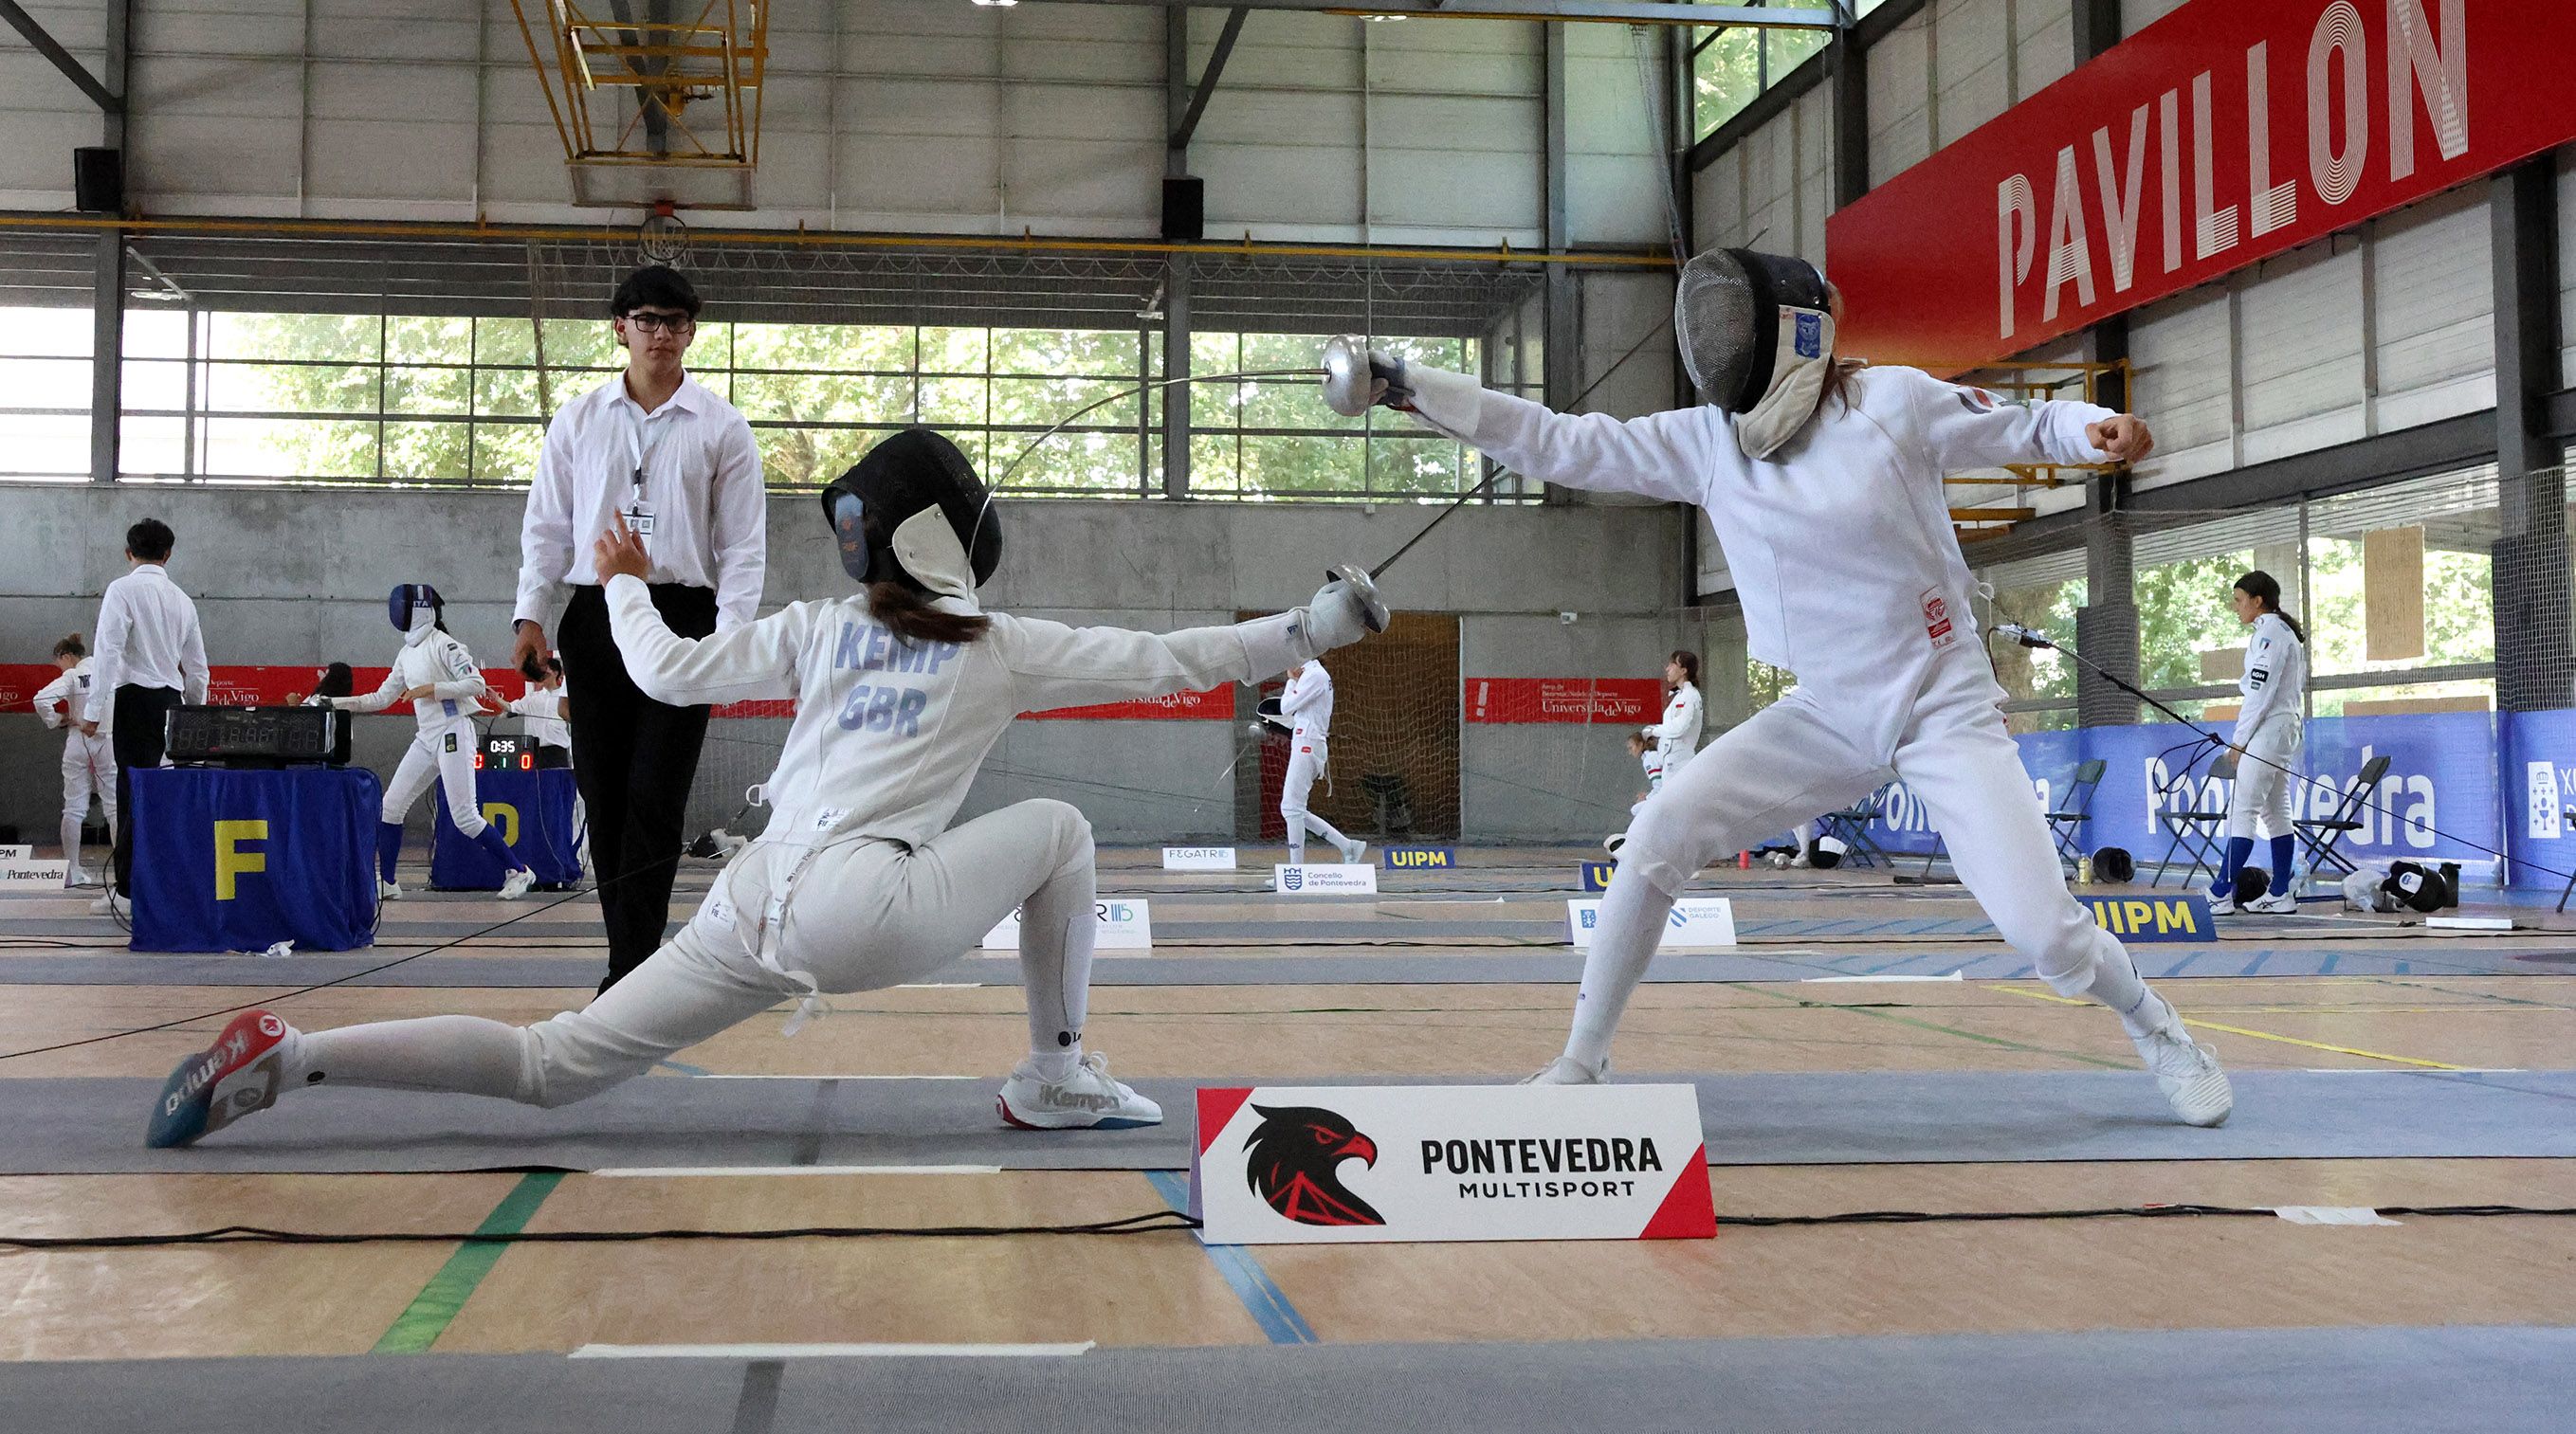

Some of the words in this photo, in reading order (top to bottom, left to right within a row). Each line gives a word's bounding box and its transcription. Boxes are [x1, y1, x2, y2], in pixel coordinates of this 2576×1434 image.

[1998, 0, 2469, 340] PAVILLON
[835, 622, 961, 675] KEMP
[838, 685, 926, 738] GBR
[490, 740, 516, 753] 0:35
[521, 753, 531, 770] 0
[214, 820, 268, 901] F
[1392, 851, 1448, 866] UIPM
[8, 869, 64, 880] Pontevedra
[1039, 1084, 1121, 1113] Kempa
[1421, 1137, 1663, 1174] PONTEVEDRA
[1459, 1181, 1635, 1198] MULTISPORT
